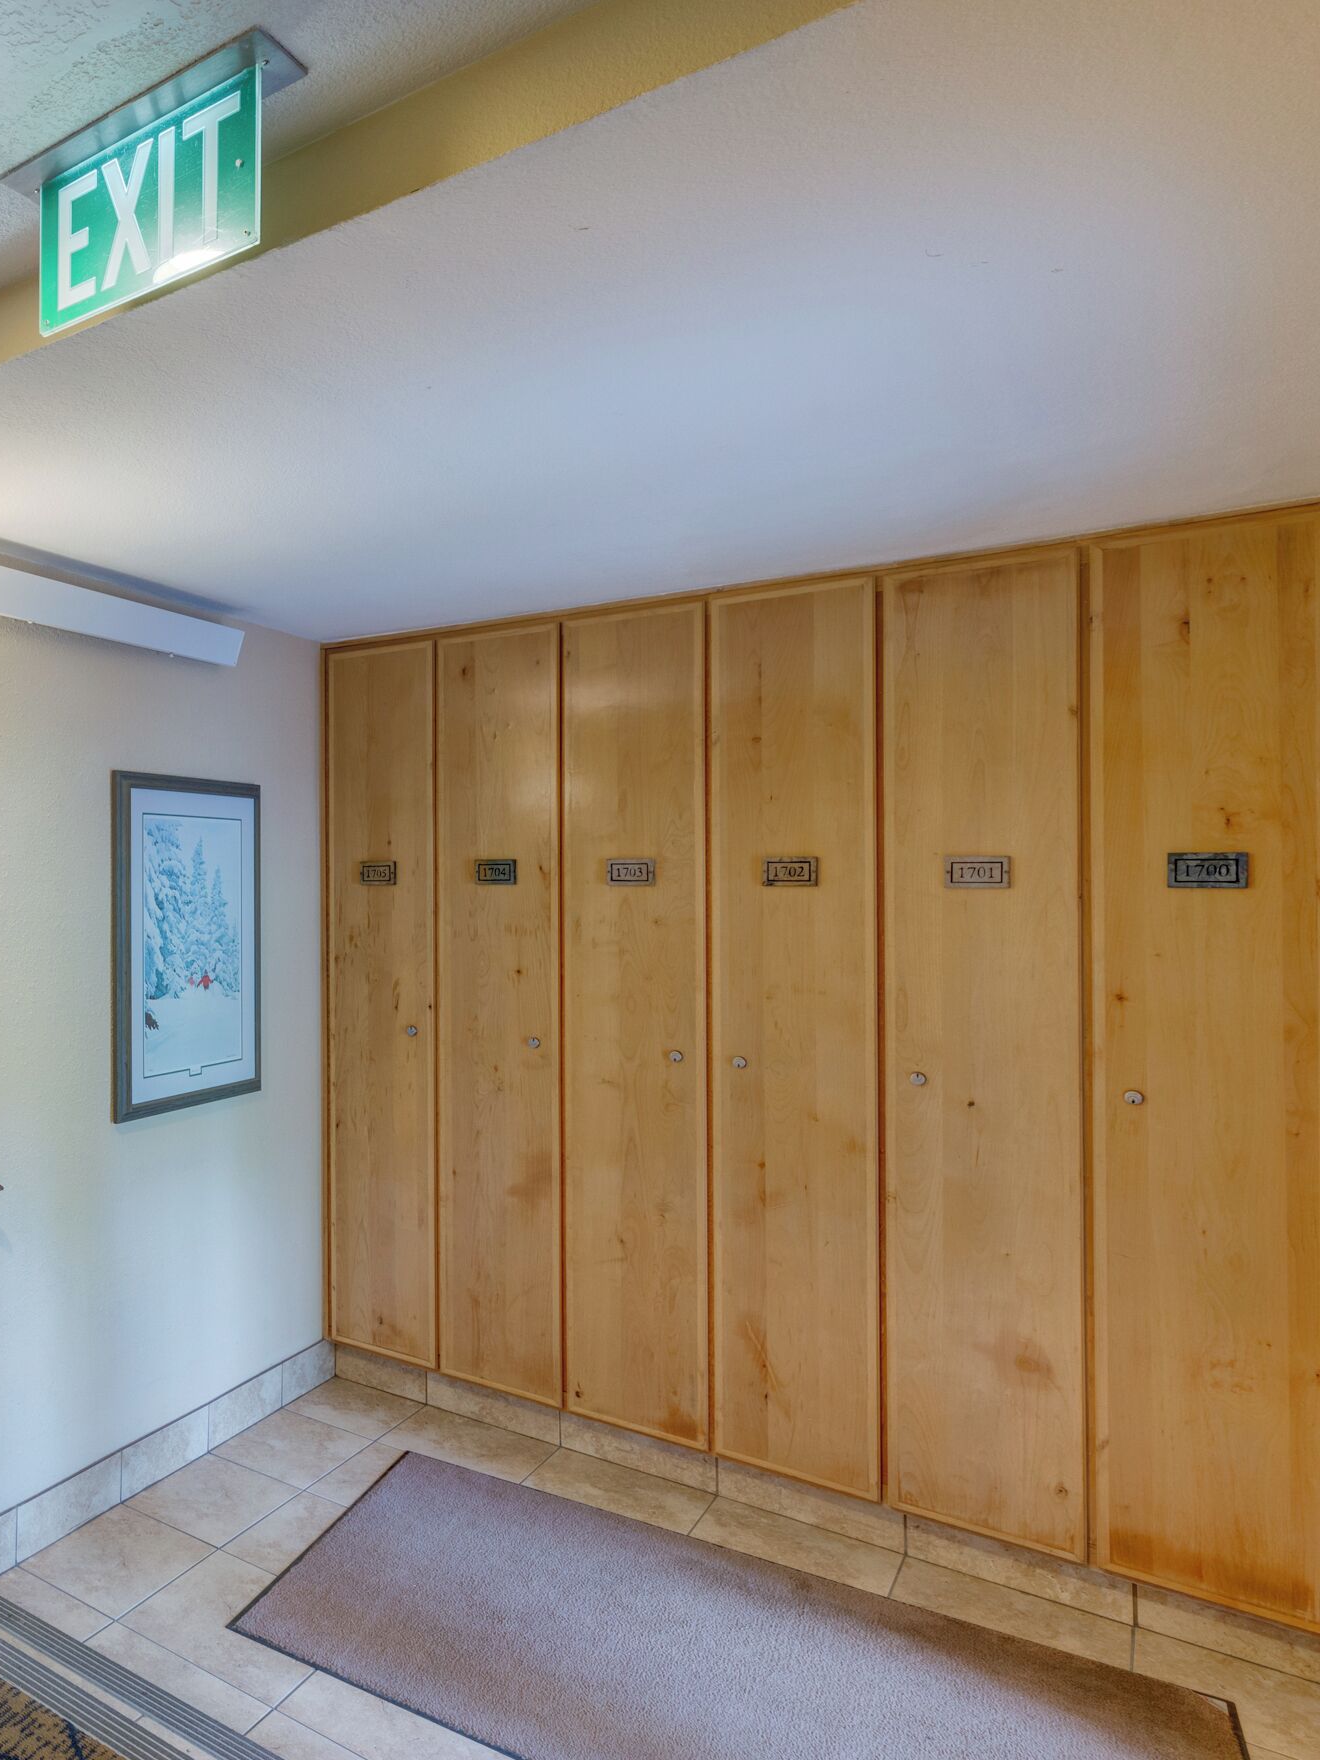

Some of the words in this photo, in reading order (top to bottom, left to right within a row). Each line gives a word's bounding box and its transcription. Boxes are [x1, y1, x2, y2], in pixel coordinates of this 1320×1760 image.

[57, 90, 241, 311] EXIT
[366, 869, 387, 879] 1705
[482, 867, 507, 878] 1704
[616, 867, 643, 878] 1703
[773, 866, 806, 878] 1702
[959, 866, 995, 879] 1701
[1184, 863, 1232, 878] 1700
